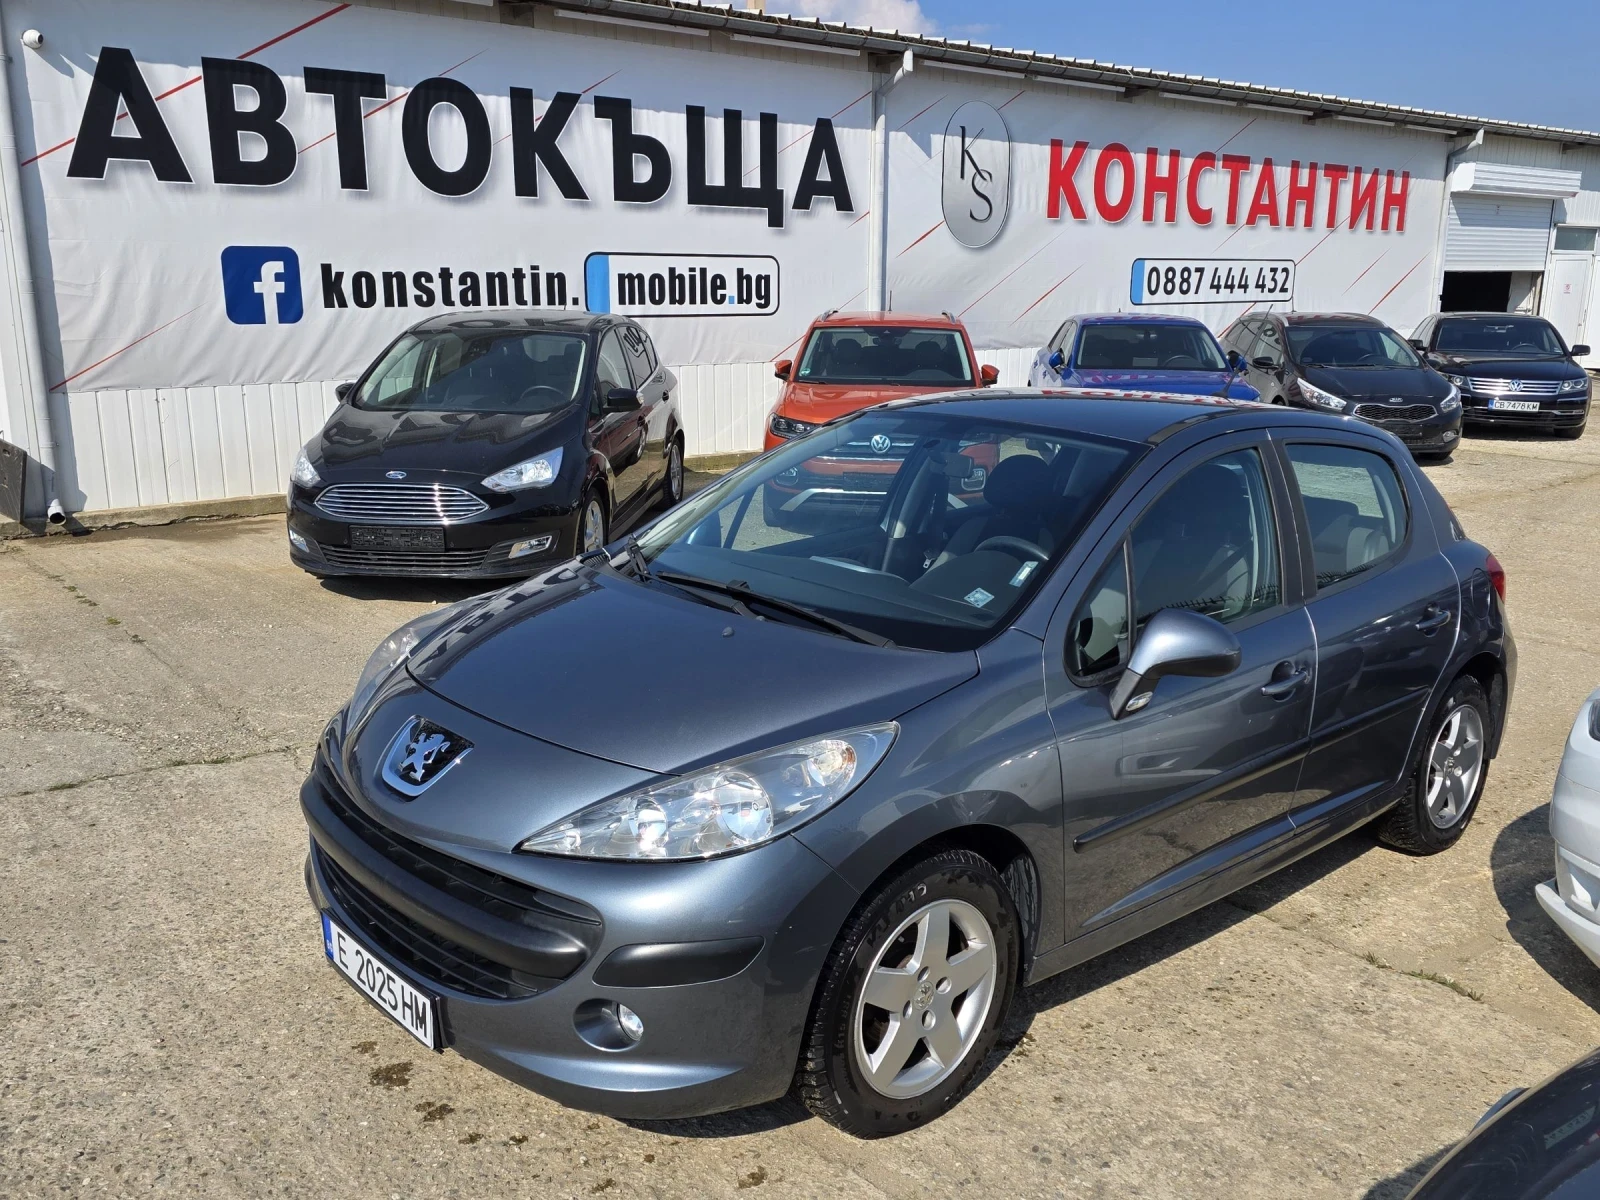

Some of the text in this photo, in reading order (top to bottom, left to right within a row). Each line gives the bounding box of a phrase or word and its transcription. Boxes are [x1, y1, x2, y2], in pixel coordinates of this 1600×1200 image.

[66, 46, 855, 229] АВТОКЪЩА
[1046, 138, 1411, 232] КОНСТАНТИН
[617, 267, 771, 309] mobile.bg
[1147, 266, 1290, 296] 0887 444 432
[337, 931, 428, 1039] E 2025 HM
